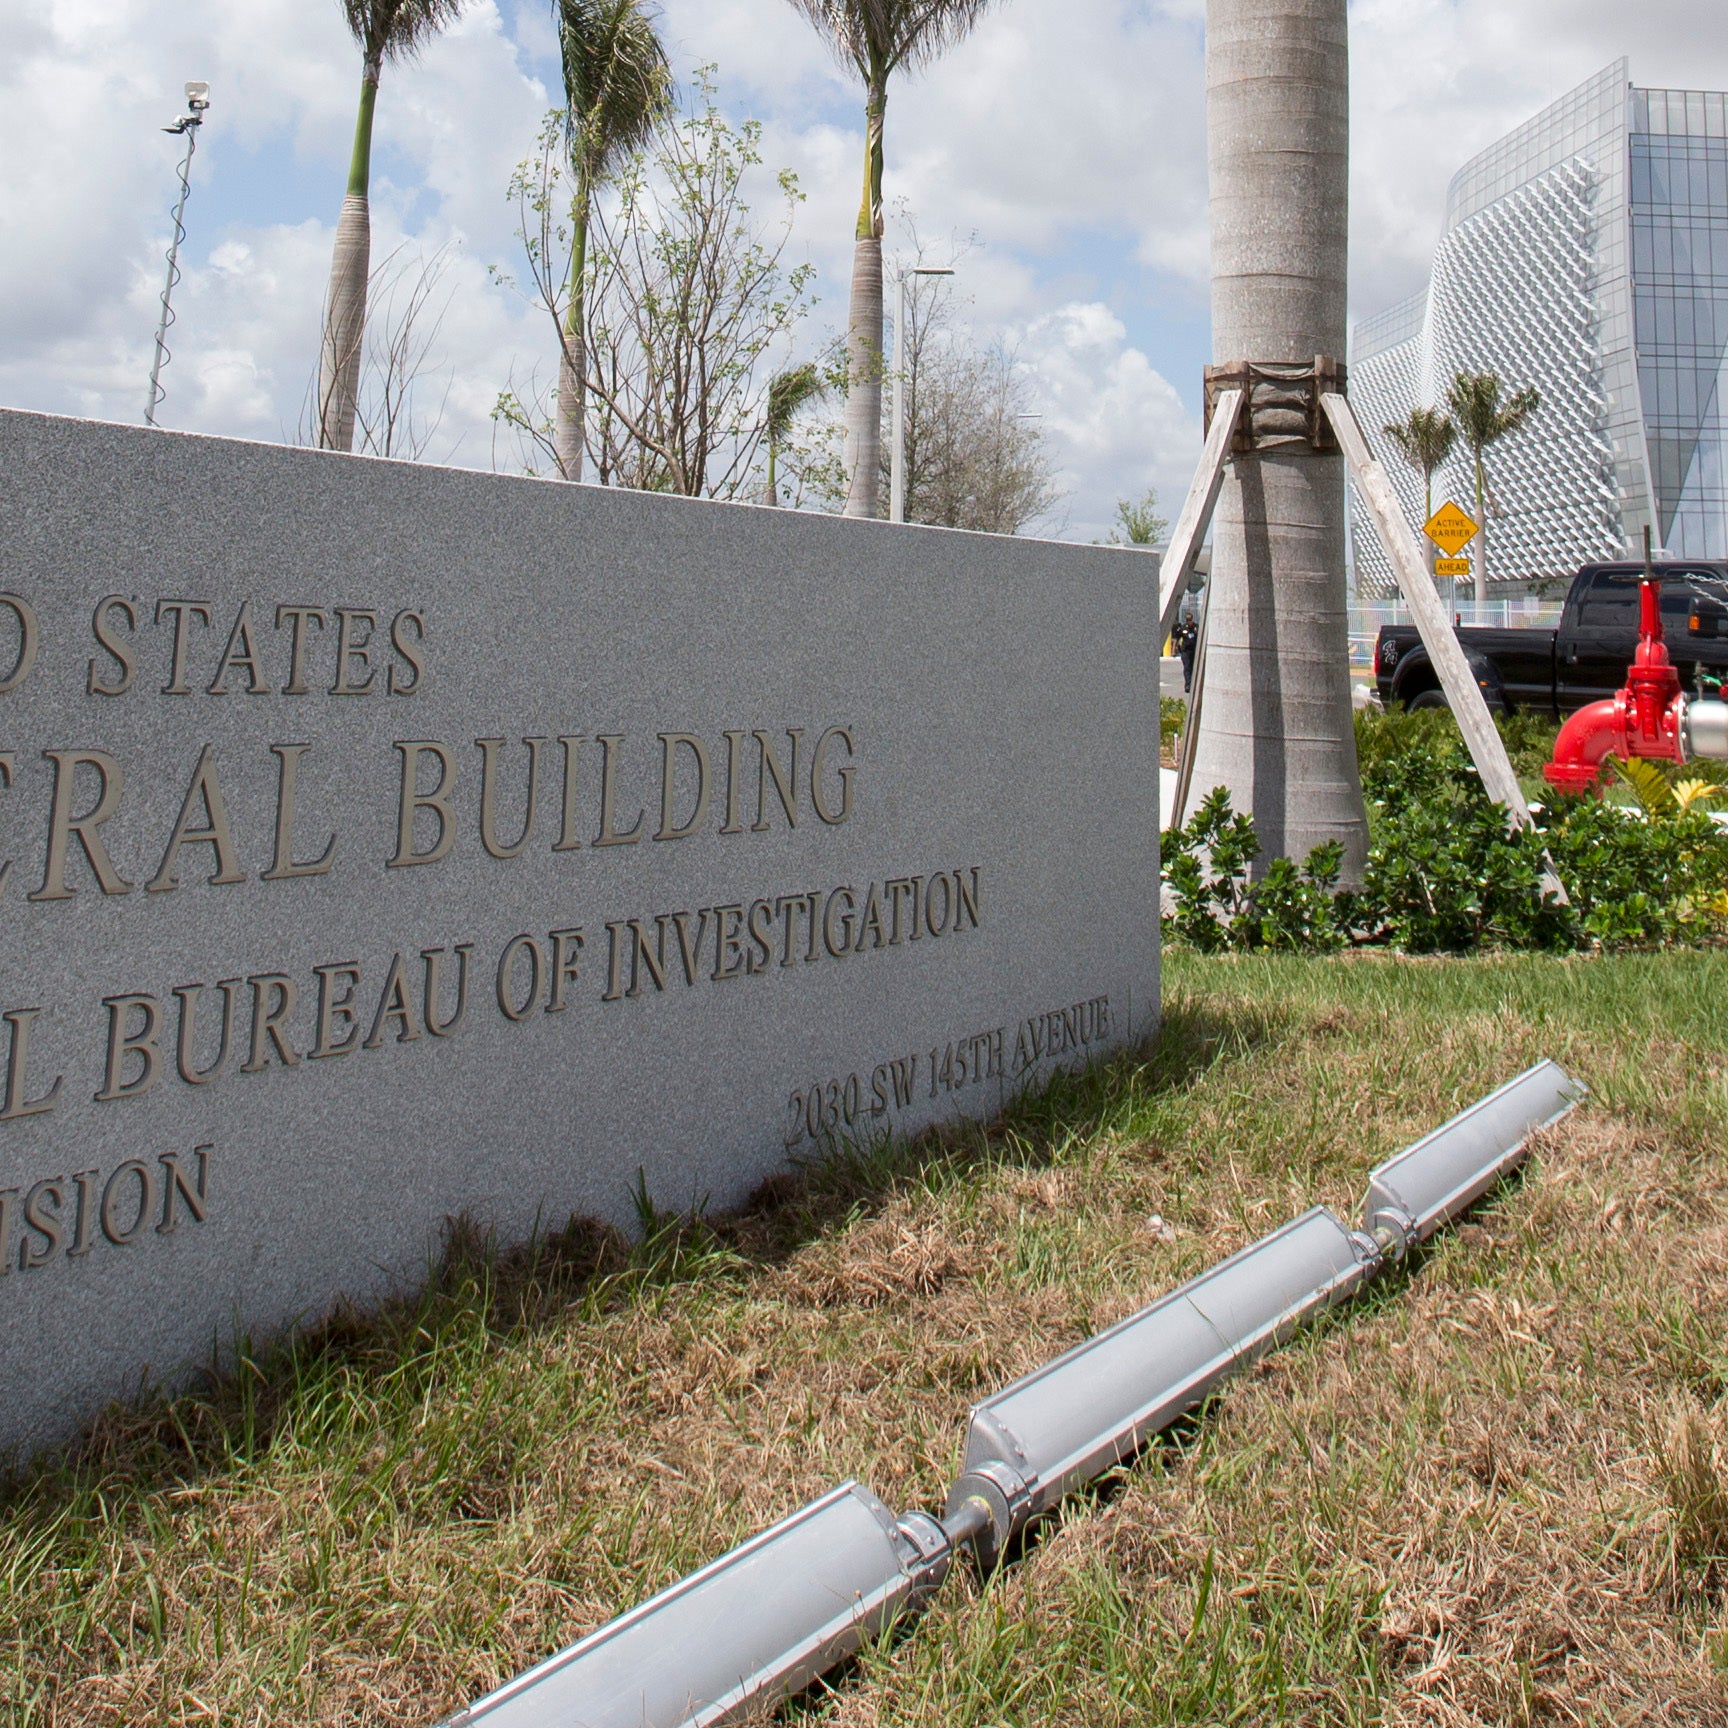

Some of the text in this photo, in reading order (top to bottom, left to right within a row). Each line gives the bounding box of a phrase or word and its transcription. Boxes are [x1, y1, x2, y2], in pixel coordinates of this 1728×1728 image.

[1432, 529, 1470, 538] BARRIER
[1436, 519, 1466, 528] ACTIVE
[1438, 562, 1467, 571] AHEAD
[86, 593, 427, 698] STATES
[386, 724, 858, 869] BUILDING
[95, 943, 474, 1103] BUREAU
[496, 927, 584, 1021] OF
[602, 866, 982, 1002] INVESTIGATION
[784, 994, 1110, 1147] 2030 SW 145TH AVENUE
